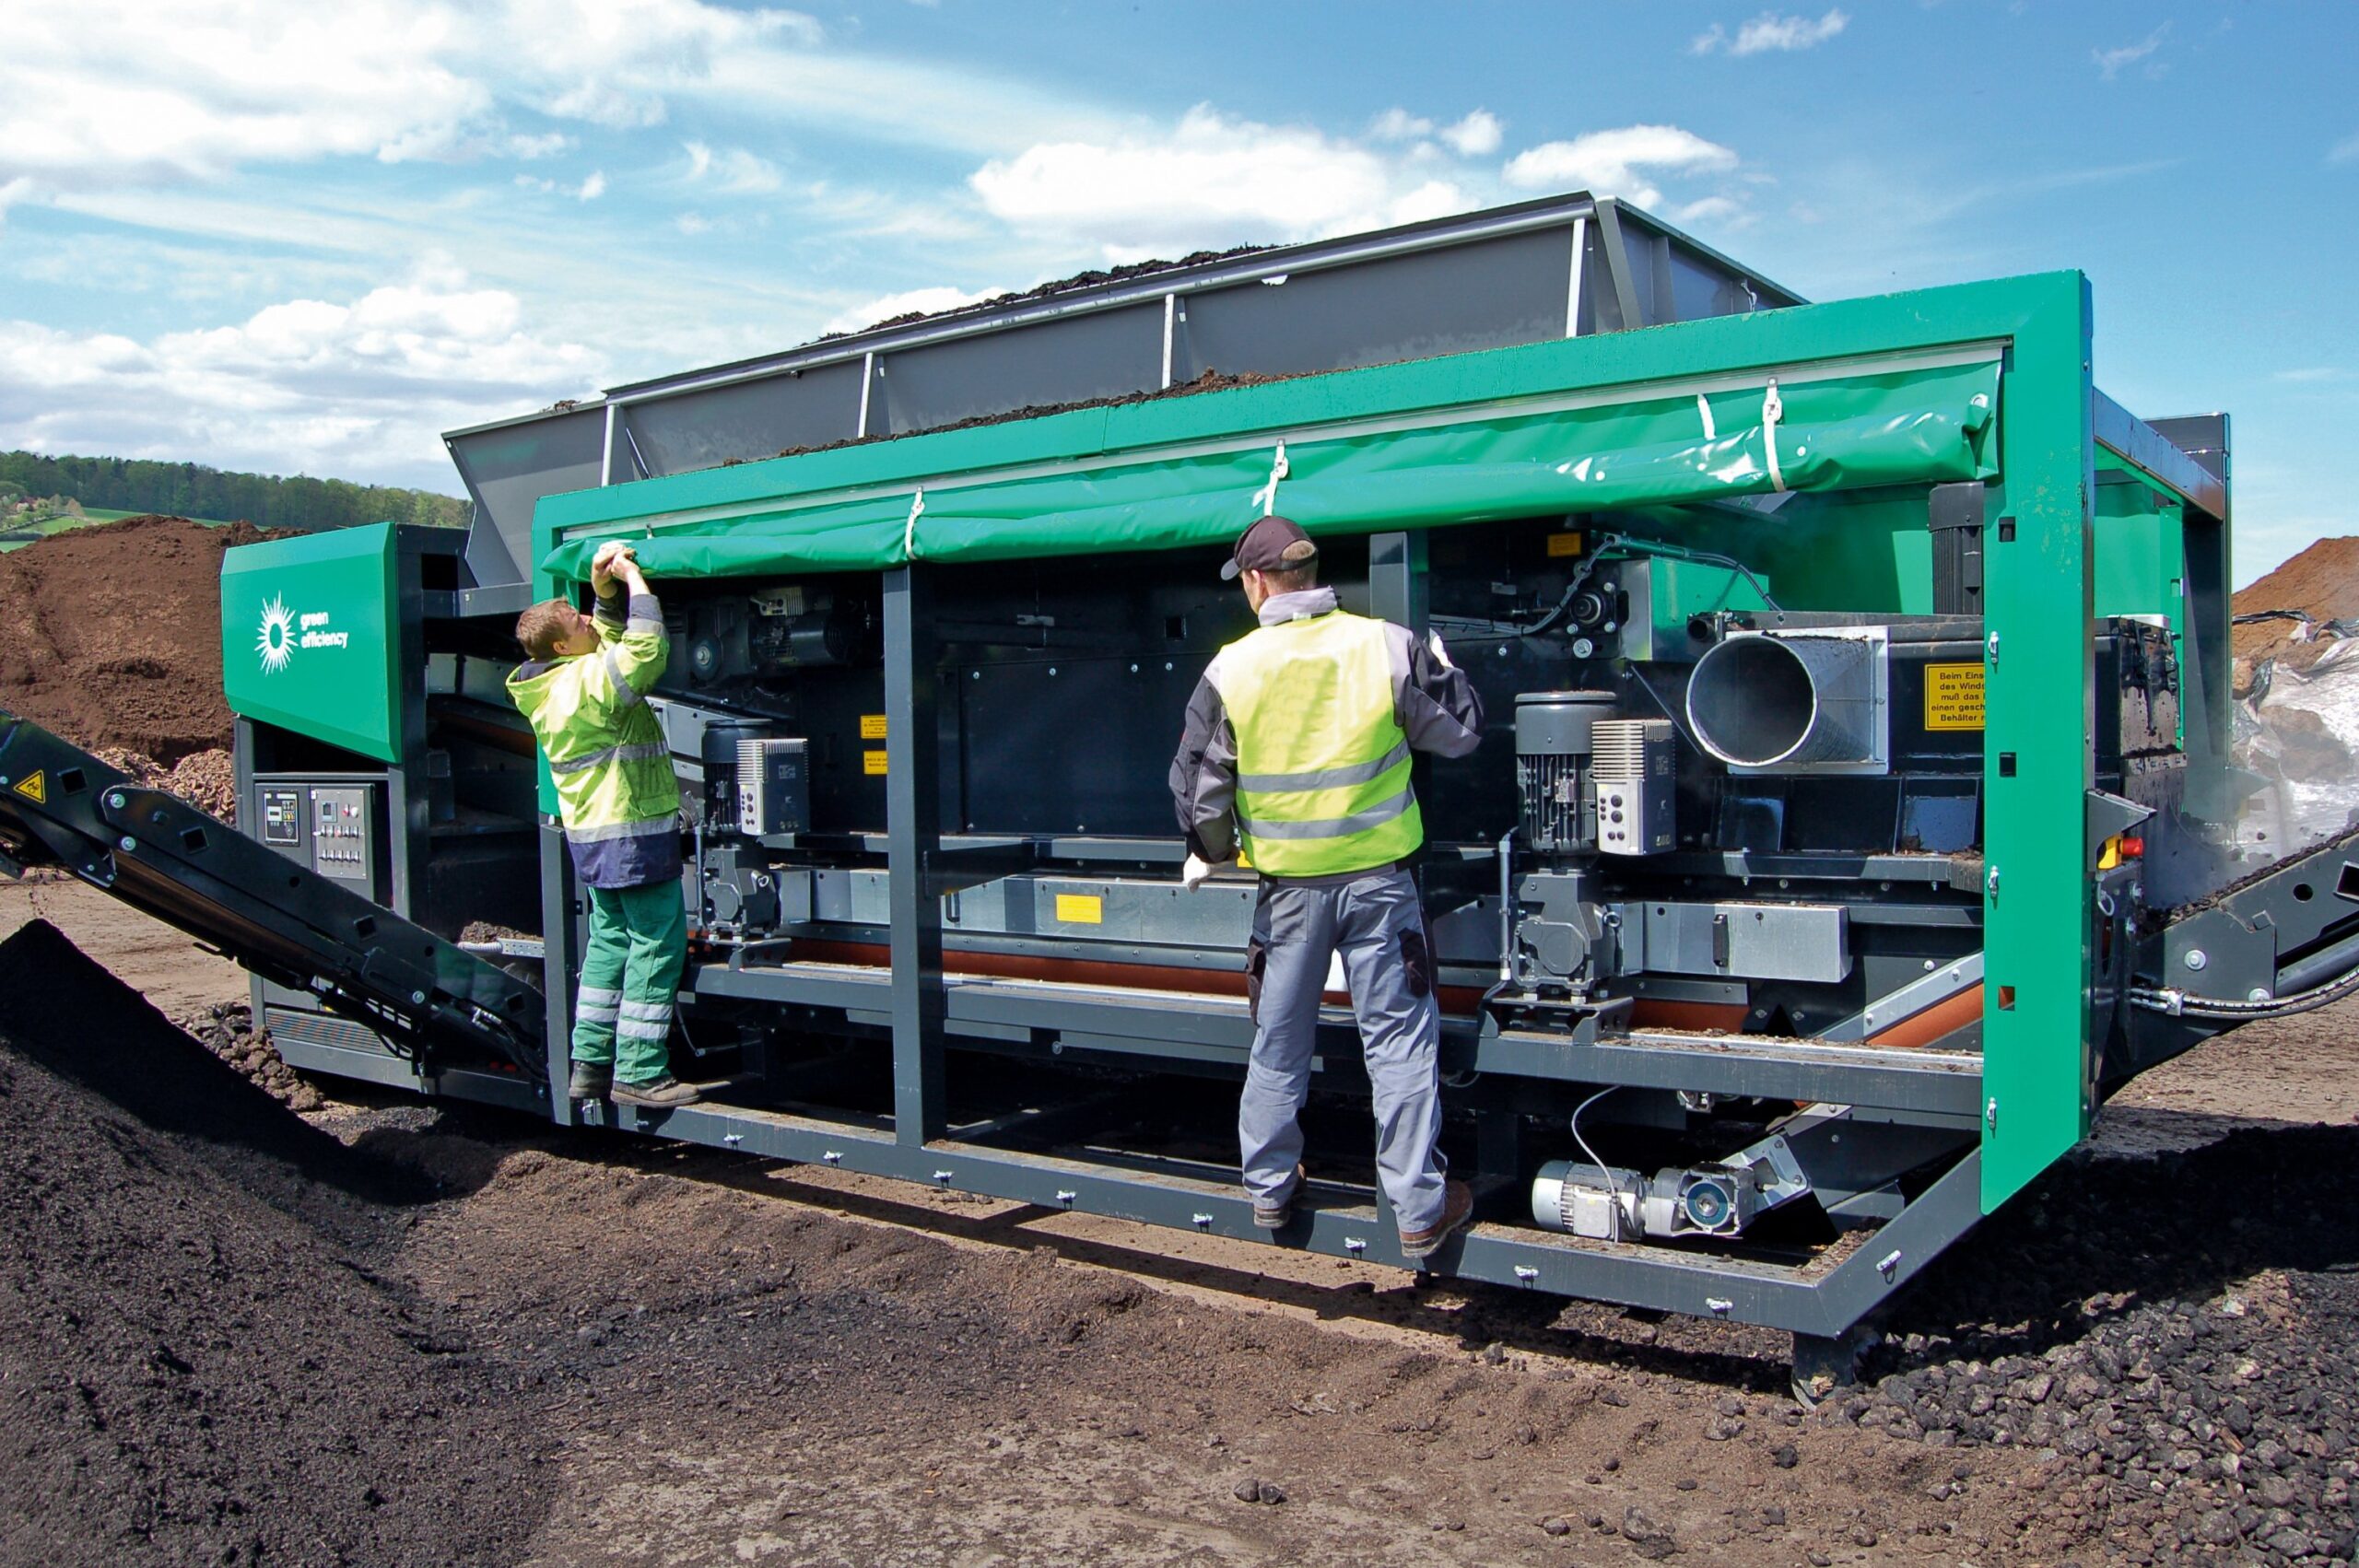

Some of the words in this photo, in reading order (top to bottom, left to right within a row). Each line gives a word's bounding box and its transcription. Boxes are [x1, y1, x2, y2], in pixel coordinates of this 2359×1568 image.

[300, 612, 329, 631] green
[301, 631, 348, 649] efficiency
[1940, 672, 1962, 680] Beim
[1931, 703, 1954, 711] einen
[1941, 713, 1977, 721] Behälter
